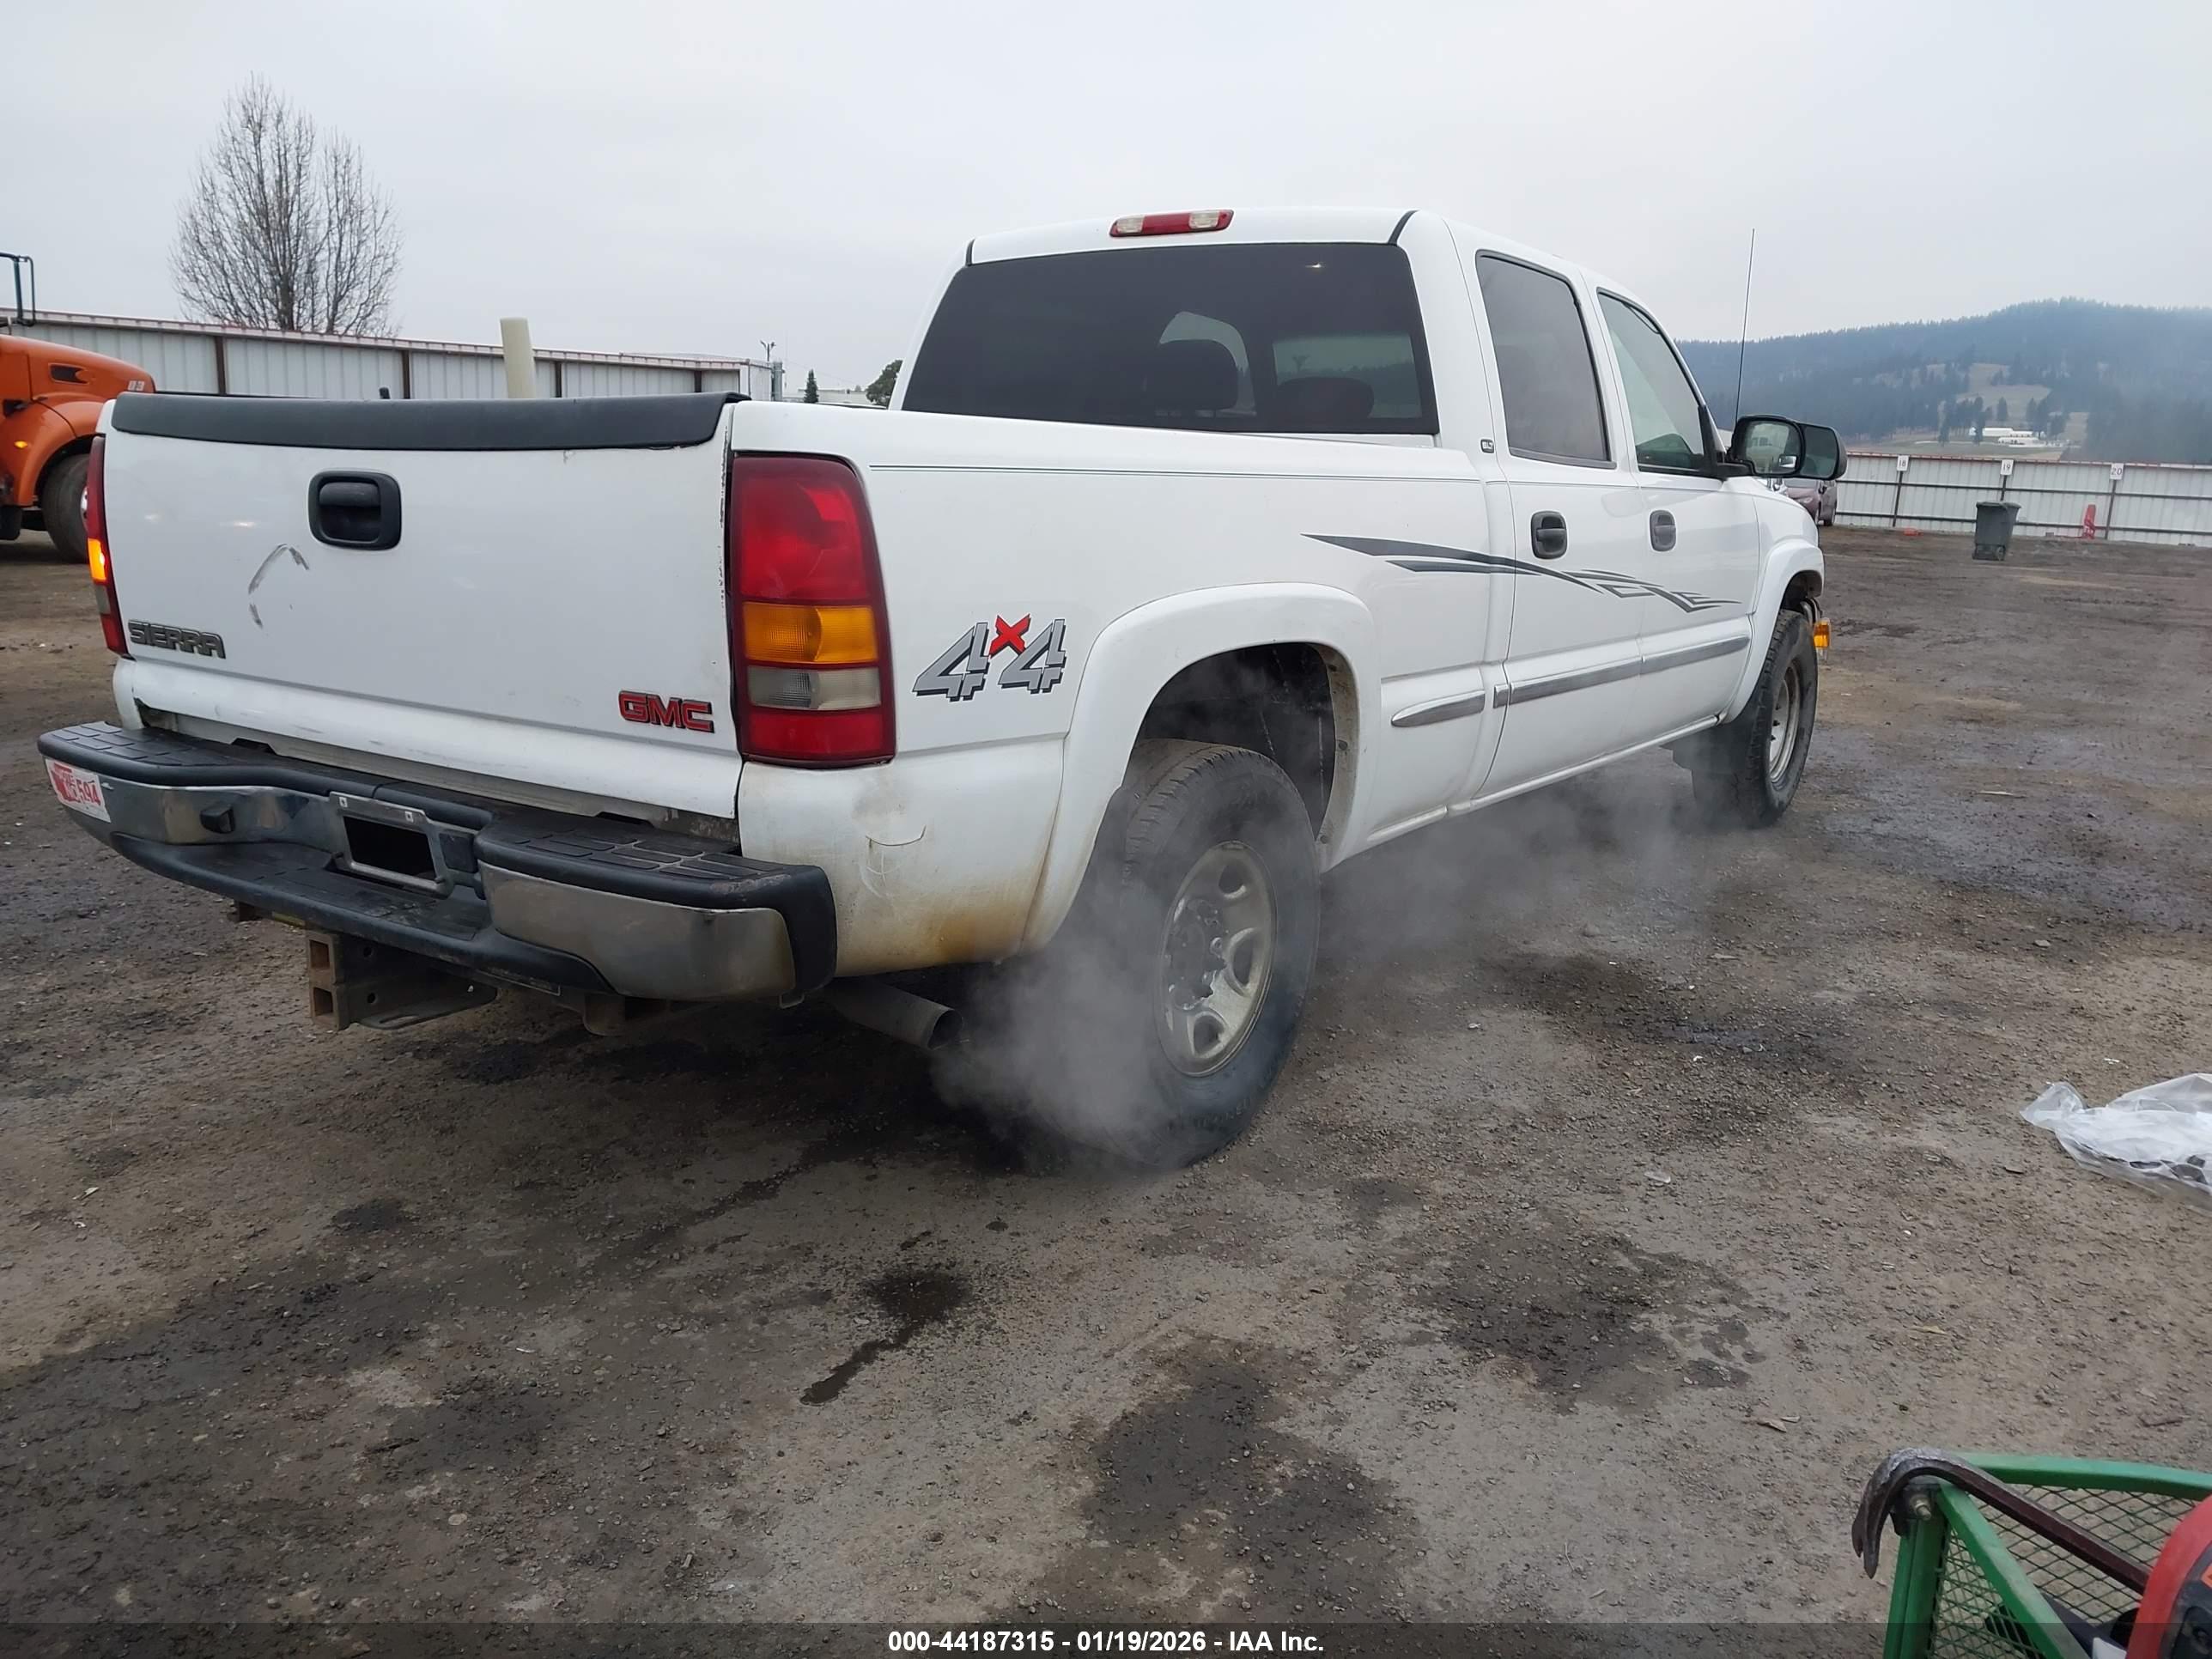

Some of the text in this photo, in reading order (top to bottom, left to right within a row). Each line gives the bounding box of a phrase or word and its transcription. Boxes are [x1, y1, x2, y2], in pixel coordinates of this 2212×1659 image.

[2111, 466, 2123, 476] 20
[128, 619, 227, 659] SIERRA
[618, 690, 714, 733] GMC
